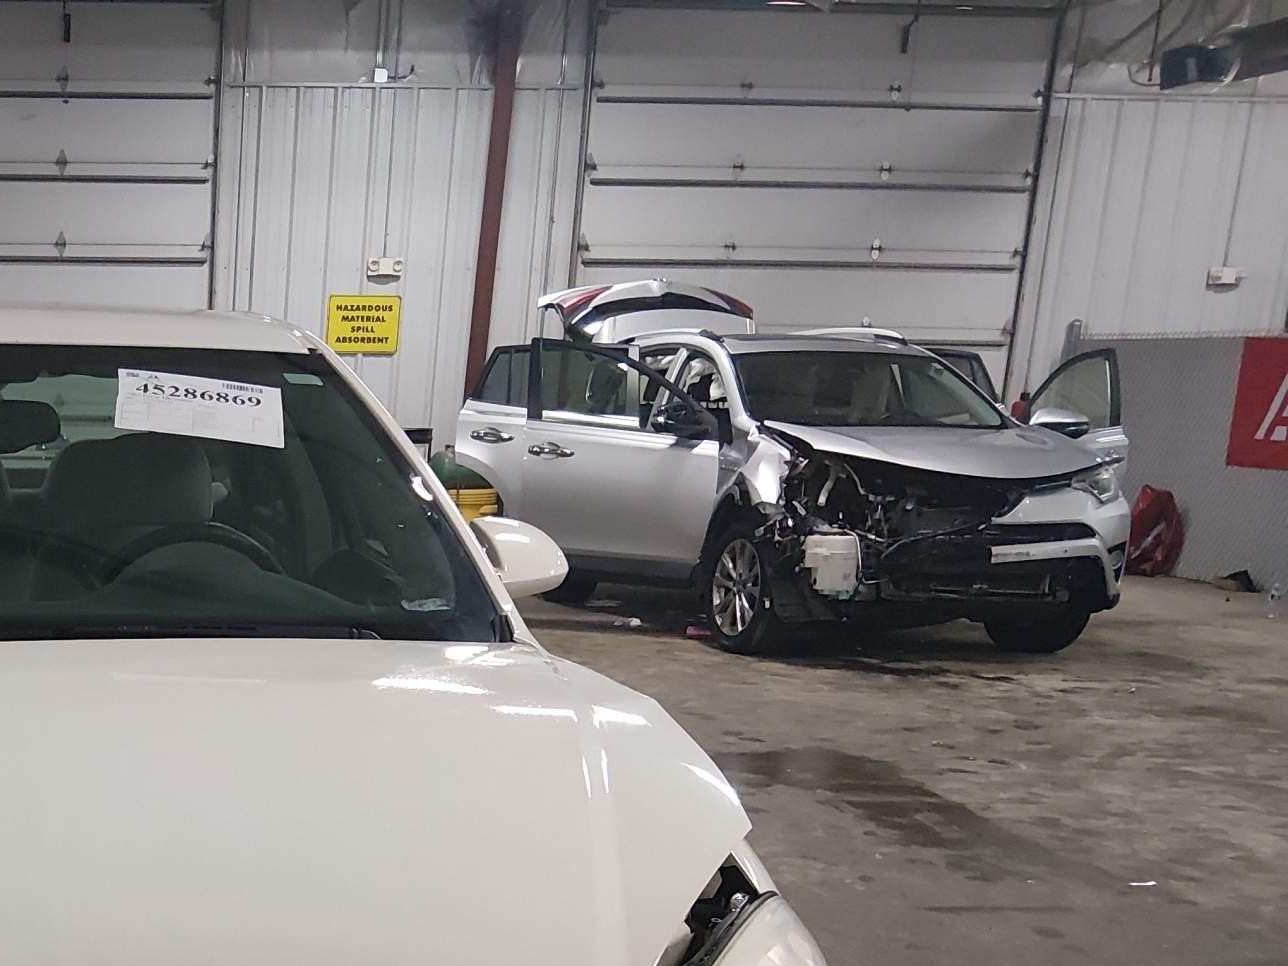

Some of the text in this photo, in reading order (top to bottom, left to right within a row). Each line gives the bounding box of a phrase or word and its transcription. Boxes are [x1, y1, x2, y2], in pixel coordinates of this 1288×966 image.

[336, 304, 394, 312] HAZARDOUS
[340, 315, 386, 323] MATERIAL
[350, 325, 376, 333] SPILL
[335, 336, 390, 344] ABSORBENT
[135, 382, 262, 407] 45286869
